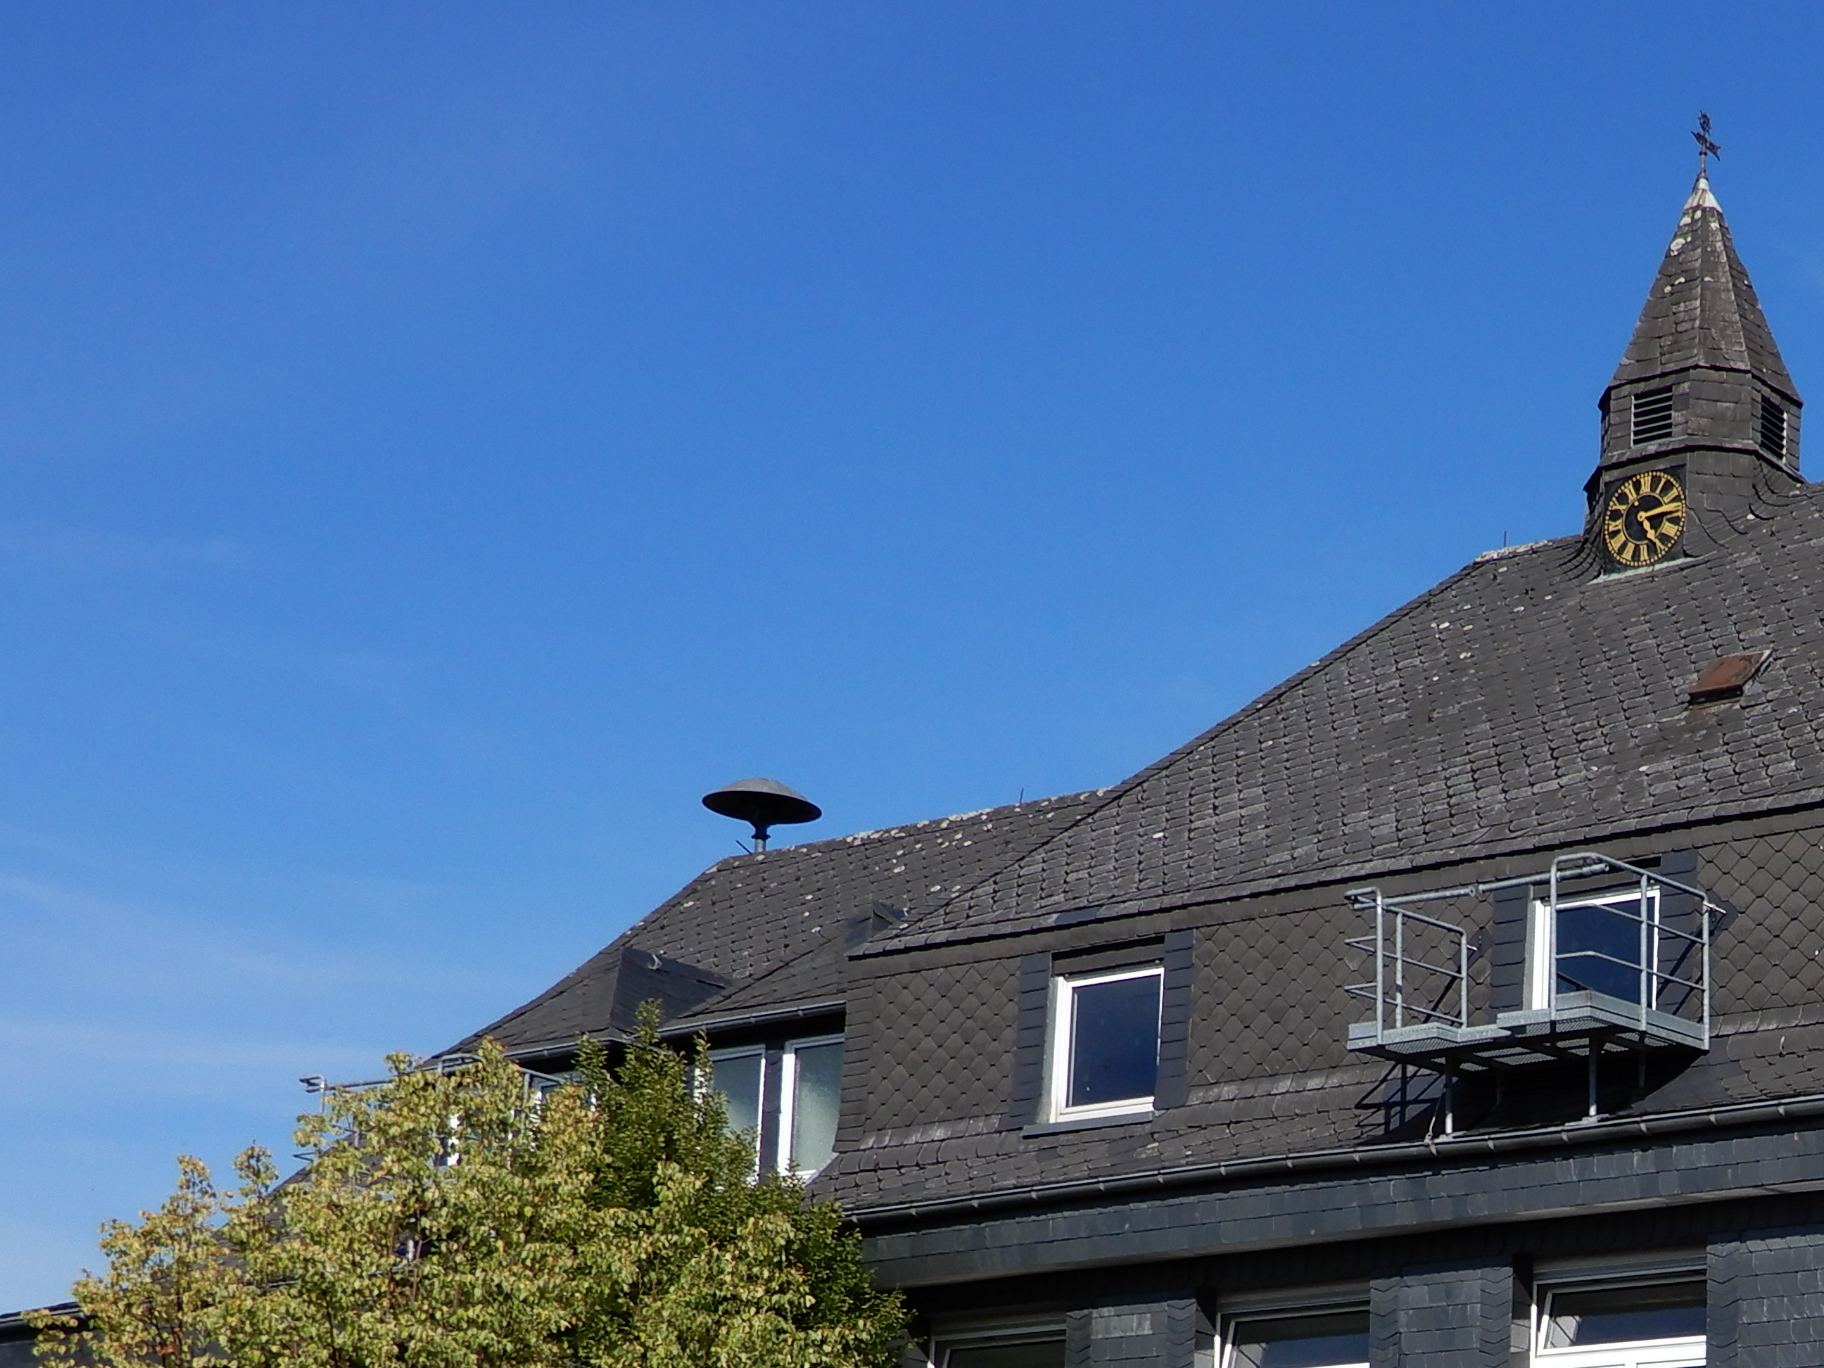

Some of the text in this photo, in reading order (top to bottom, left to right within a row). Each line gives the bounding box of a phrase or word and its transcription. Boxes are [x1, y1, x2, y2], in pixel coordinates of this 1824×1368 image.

[1655, 478, 1667, 494] I
[1663, 487, 1679, 503] II
[1611, 498, 1627, 514] X
